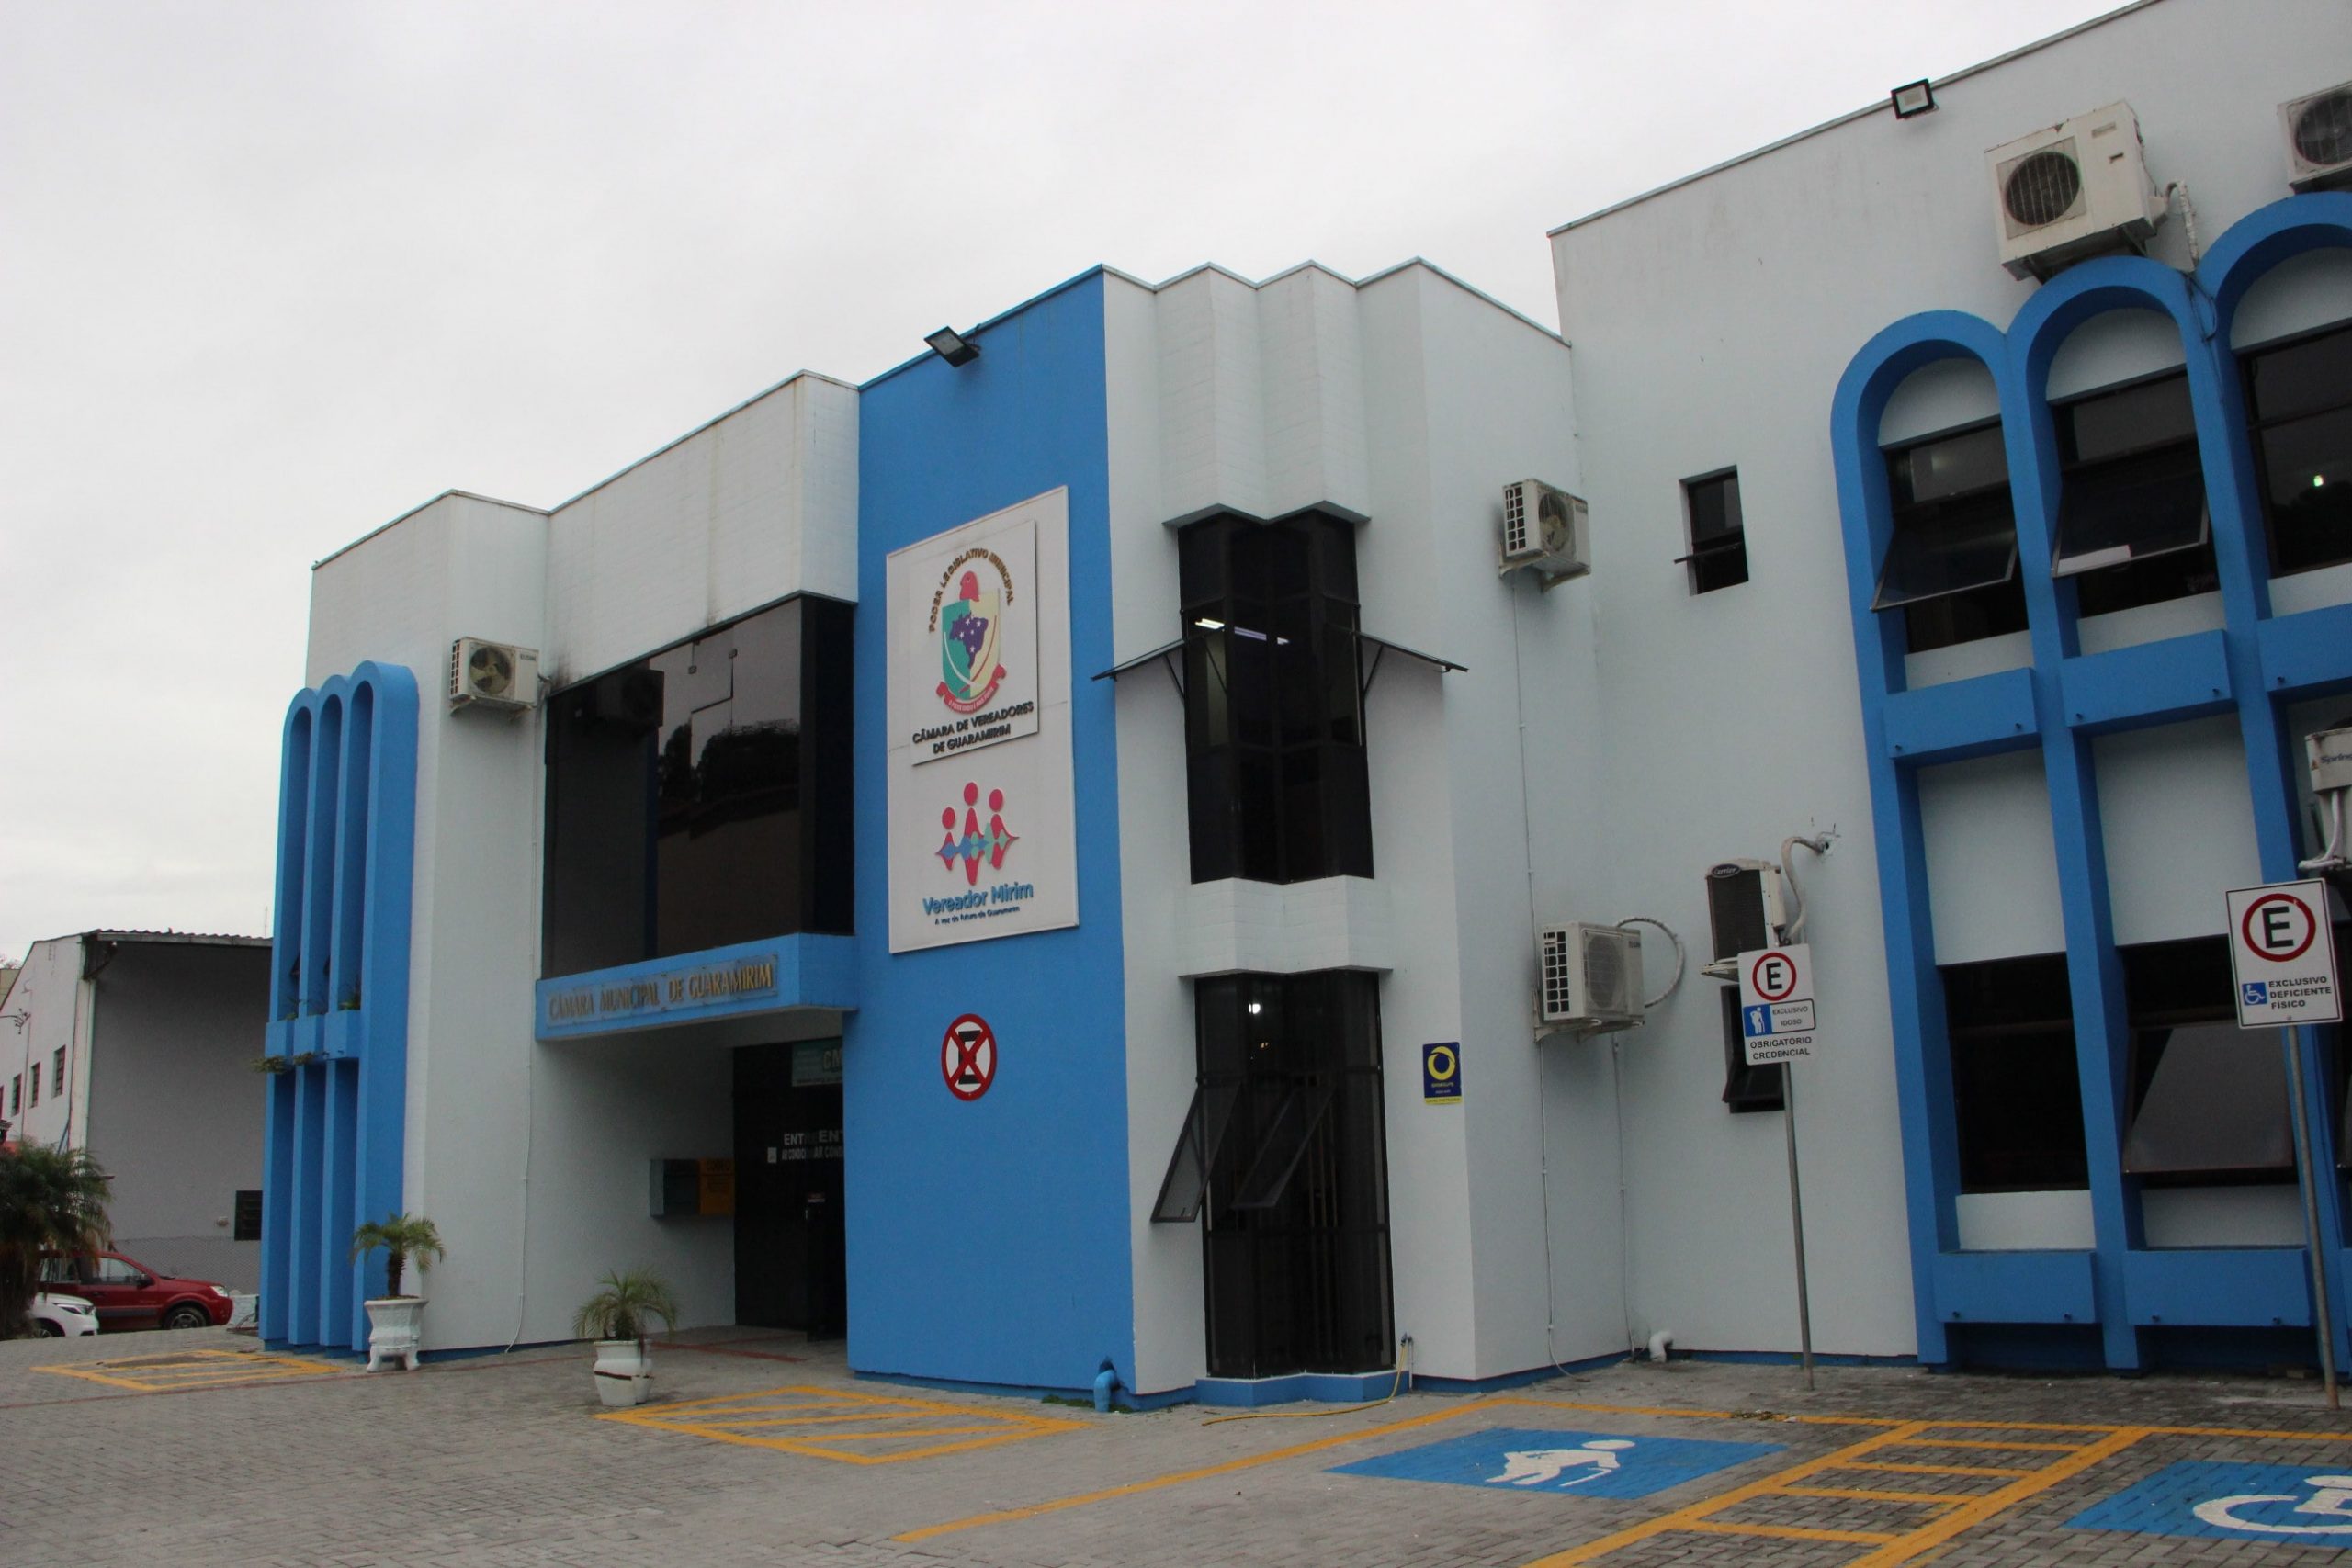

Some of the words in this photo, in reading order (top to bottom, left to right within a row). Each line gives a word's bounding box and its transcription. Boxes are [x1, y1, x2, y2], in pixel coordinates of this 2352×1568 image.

[929, 590, 943, 634] PODER
[940, 547, 989, 588] LEGISLATIVO
[989, 551, 1014, 606] MUNICIPAL
[912, 724, 955, 744] CÂMARA
[956, 718, 969, 733] DE
[970, 701, 1035, 727] VEREADORES
[933, 740, 945, 754] DE
[947, 723, 1011, 750] GUARAMIRIM
[922, 889, 988, 915] Vereador
[991, 881, 1034, 904] Mirim
[2262, 906, 2294, 949] E
[599, 982, 661, 1011] MUNICIPAL
[668, 977, 684, 1002] DE
[688, 963, 774, 998] GUARAMIRIM
[1766, 962, 1782, 990] E
[2268, 976, 2327, 988] EXCLUSIVO
[2270, 987, 2332, 998] DEFICIENTE
[1772, 1006, 1808, 1016] EXCLUSIVO
[1781, 1018, 1803, 1027] IDOSO
[1753, 1048, 1810, 1060] CREDENCIAL
